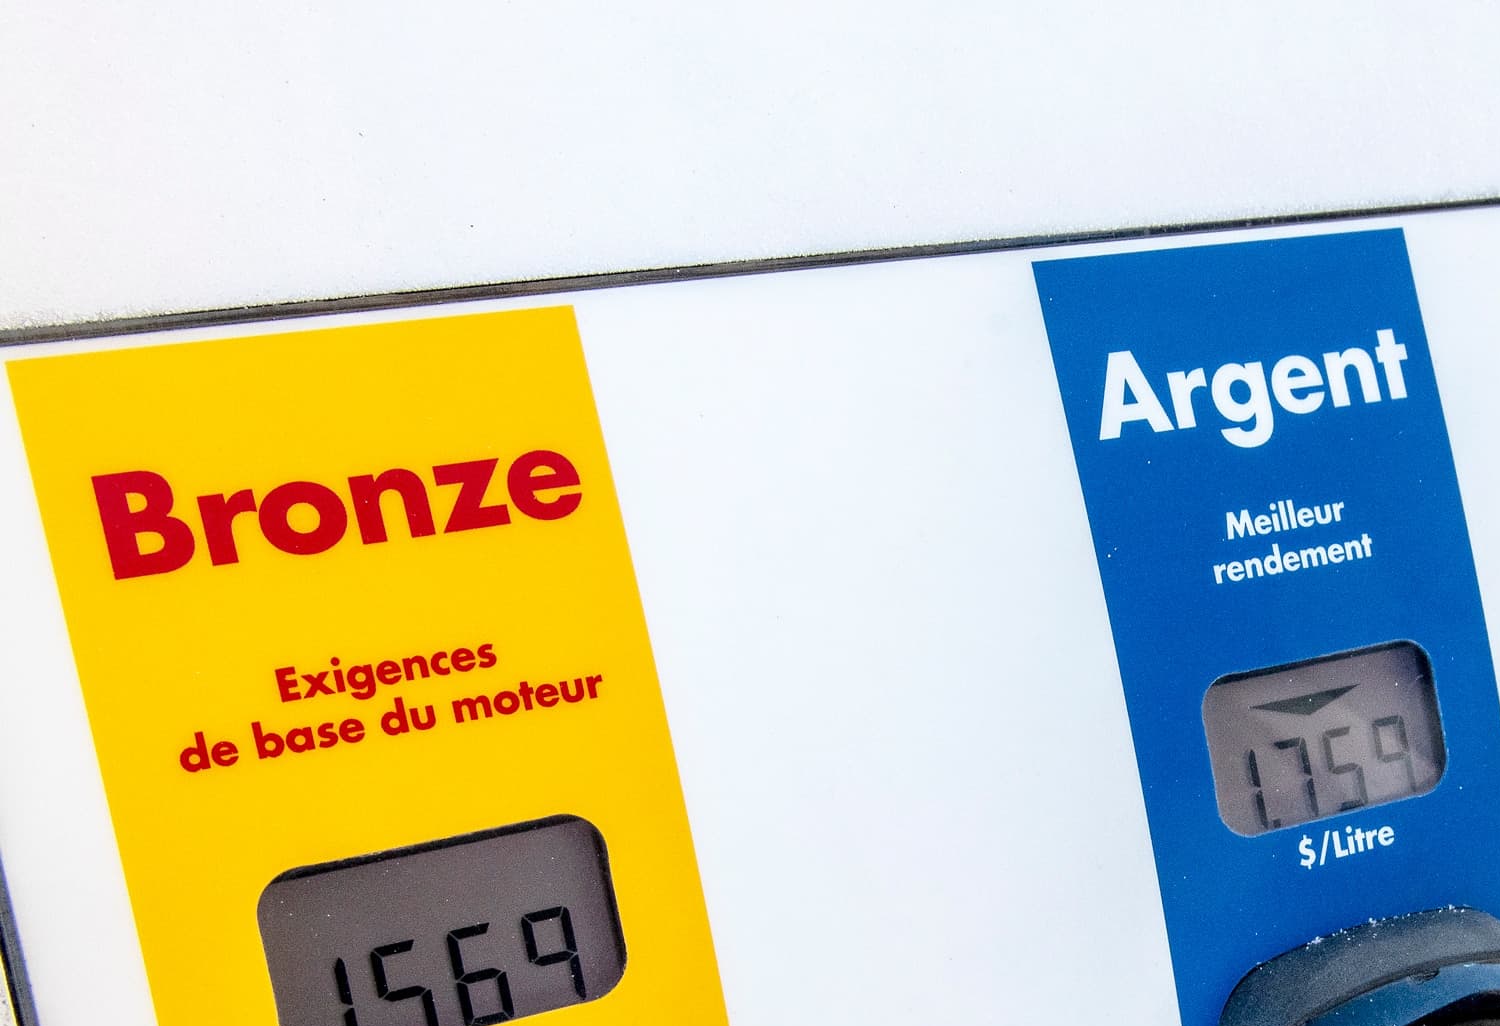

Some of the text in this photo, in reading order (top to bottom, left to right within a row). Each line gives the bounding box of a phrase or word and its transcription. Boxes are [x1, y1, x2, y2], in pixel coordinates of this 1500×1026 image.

[1100, 329, 1407, 447] Argent
[91, 450, 582, 580] Bronze
[1227, 500, 1344, 539] Meilleur
[1214, 534, 1371, 583] rendement
[275, 644, 497, 702] Exigences
[180, 675, 602, 772] de base du moteur
[1245, 714, 1416, 830] 1.759
[1299, 826, 1394, 869] $/Litre
